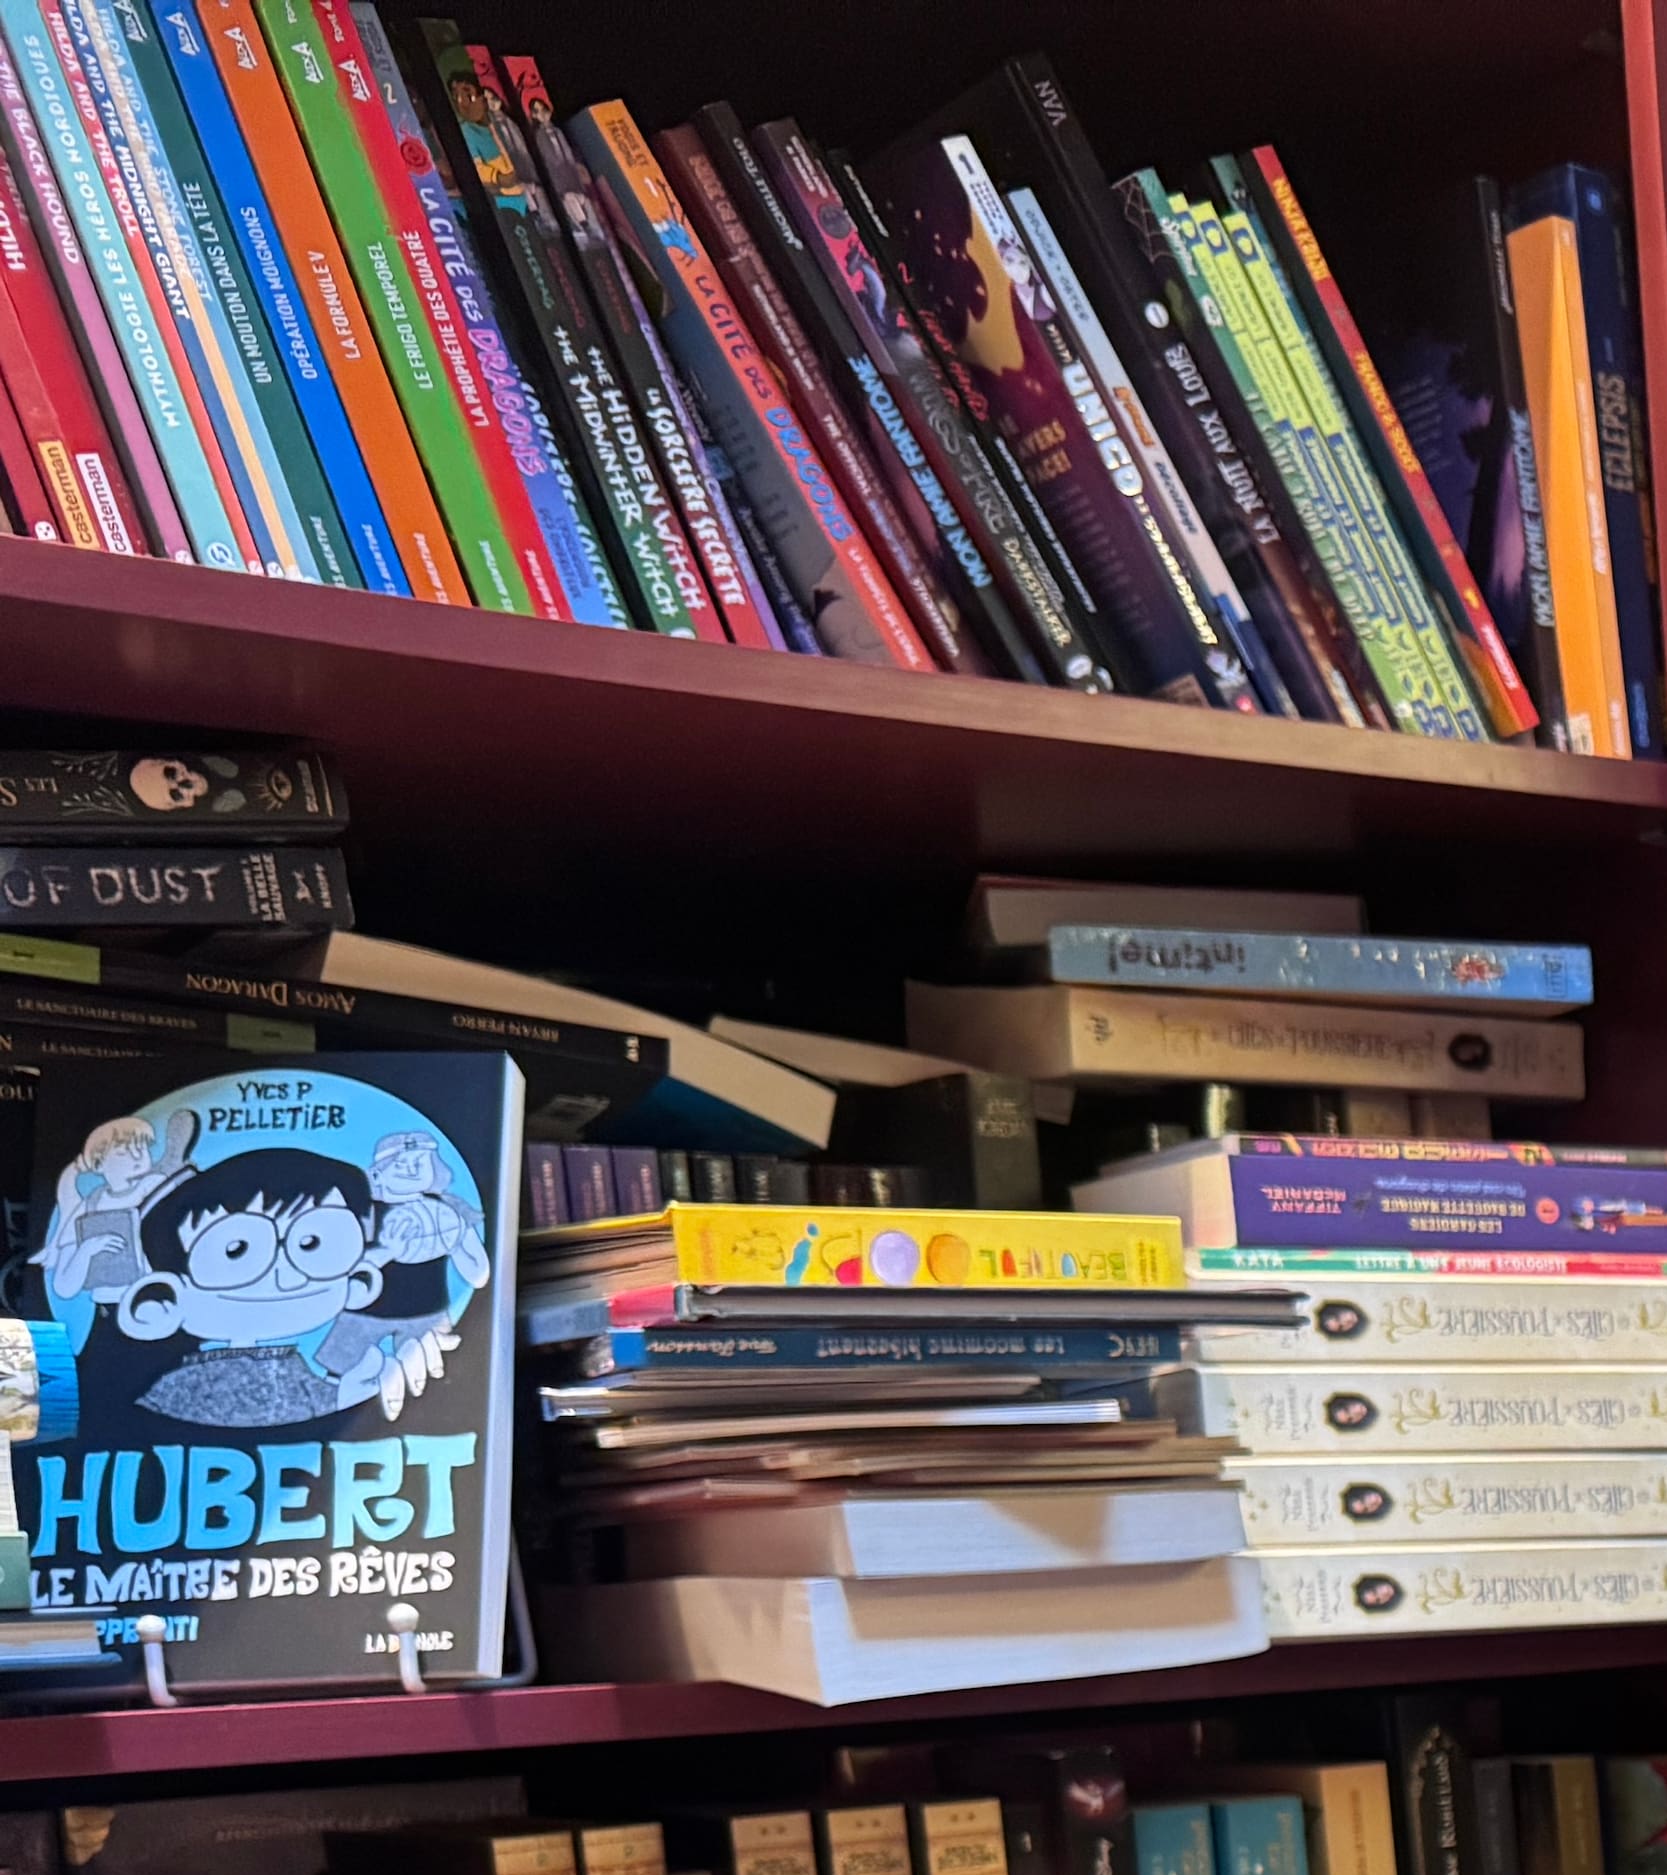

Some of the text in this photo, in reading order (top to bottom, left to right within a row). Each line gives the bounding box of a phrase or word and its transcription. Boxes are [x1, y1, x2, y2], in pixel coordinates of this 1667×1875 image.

[48, 11, 141, 237] HILDA AND THE TROLL
[1032, 77, 1071, 128] VAN
[11, 108, 49, 177] BLACK
[39, 183, 79, 264] HOUND
[83, 52, 190, 319] AND THE MIDNIGHT GIANT
[24, 34, 182, 429] MYTHOLOGIE LES HÉROS NORDIQUES
[199, 221, 219, 244] LA
[207, 245, 235, 289] DANS
[224, 291, 262, 359] MOUTON
[241, 207, 318, 380] OPÉRATION MOIGNONS
[313, 264, 353, 336] FORMULE
[368, 242, 433, 390] LE FRIGO TEMPOREL
[402, 230, 490, 427] LA PROPHÉTIE DES QUATRE
[344, 336, 362, 360] LA
[419, 188, 547, 478] LA CITÉ DES DRAGONS
[250, 361, 273, 384] UN
[695, 275, 853, 543] LA CITÉ DES DRAGONS
[1062, 361, 1143, 497] UNICO
[1201, 410, 1235, 454] AUX
[48, 445, 94, 544] casterman
[555, 325, 679, 616] THE MIDWINTER WITCH
[588, 346, 613, 386] THE
[603, 388, 665, 507] HIDDEN
[653, 508, 707, 611] WITCH
[647, 405, 708, 513] SORCIÈRE
[84, 458, 127, 553] casterman
[910, 465, 993, 589] MON AMIE
[1256, 515, 1282, 545] LA
[3, 866, 222, 908] OF DUST
[33, 1000, 116, 1021] SANCTUAIRE
[187, 973, 356, 1014] AMOS DARAGON
[452, 1013, 505, 1034] PERRO
[209, 1105, 347, 1133] PELLETIER
[237, 1081, 313, 1101] YVES P
[978, 1248, 1127, 1281] BEAUTIFUL
[31, 1431, 477, 1558] HUBERT
[30, 1546, 455, 1608] LE MAÎTRE DES RÊVES
[365, 1633, 384, 1653] LA
